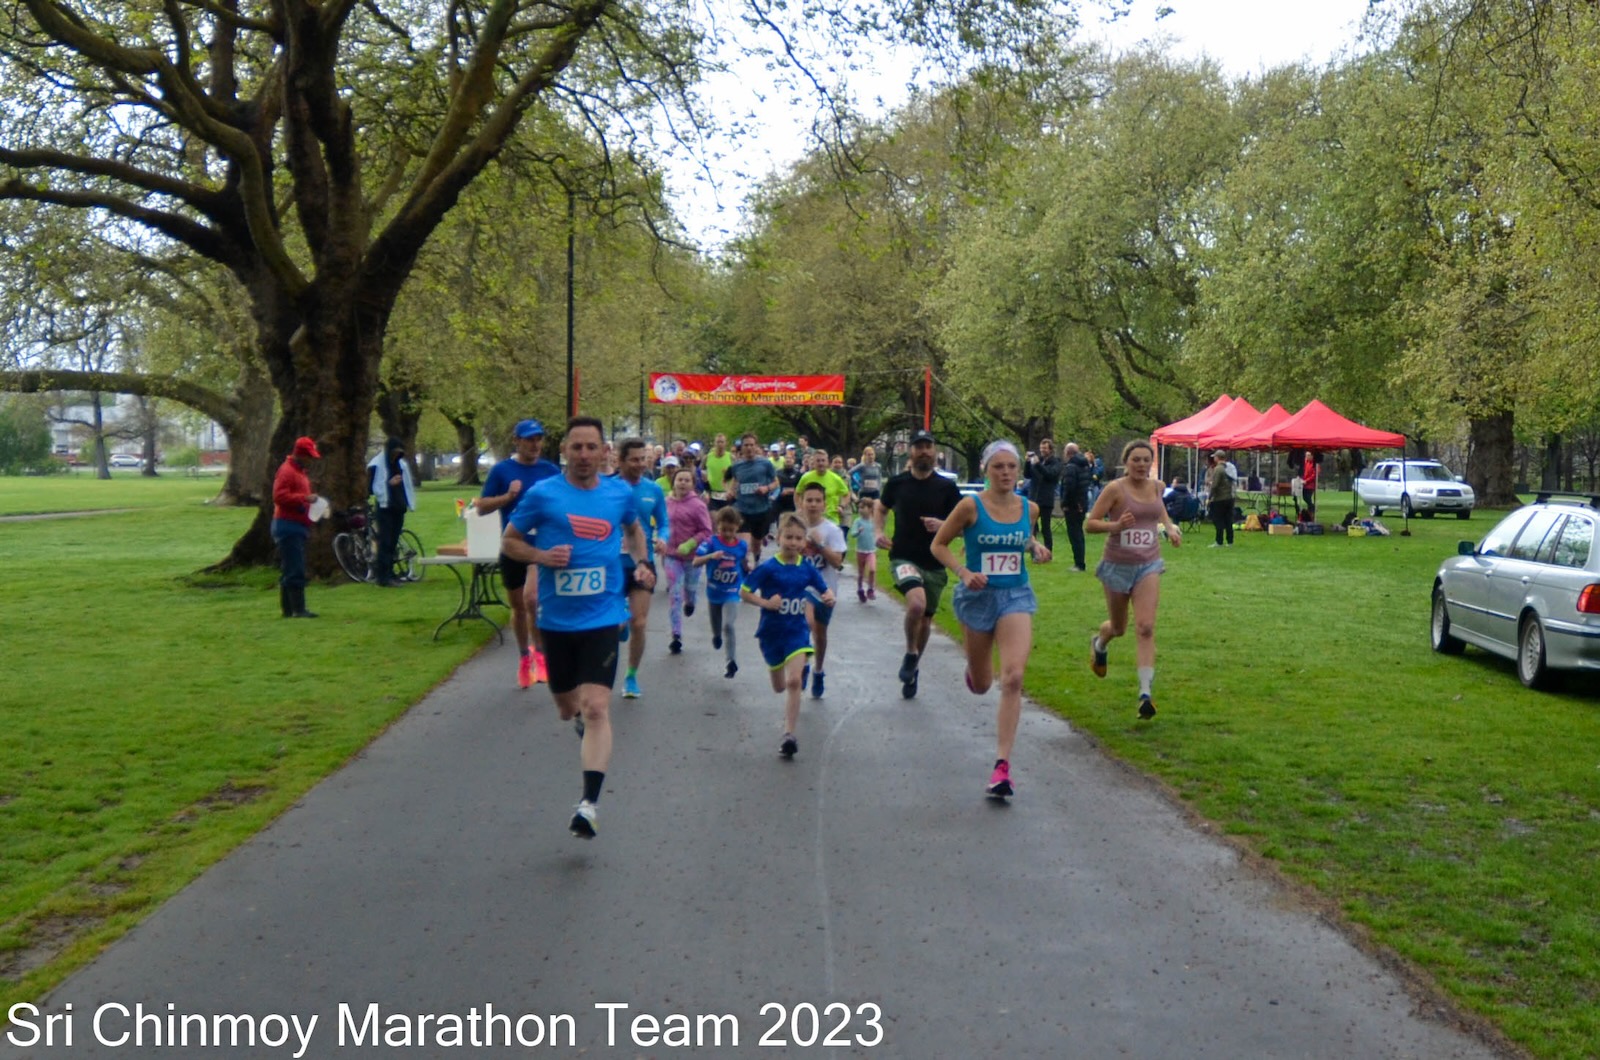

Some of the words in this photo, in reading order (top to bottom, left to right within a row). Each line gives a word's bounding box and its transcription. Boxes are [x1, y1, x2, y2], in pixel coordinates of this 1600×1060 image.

[681, 391, 698, 400] Sri
[700, 391, 748, 403] Chinmoy
[750, 392, 806, 402] Marathon
[808, 391, 840, 401] Team
[1124, 531, 1151, 545] 182
[987, 554, 1018, 572] 173
[559, 570, 602, 592] 278
[713, 568, 738, 584] 907
